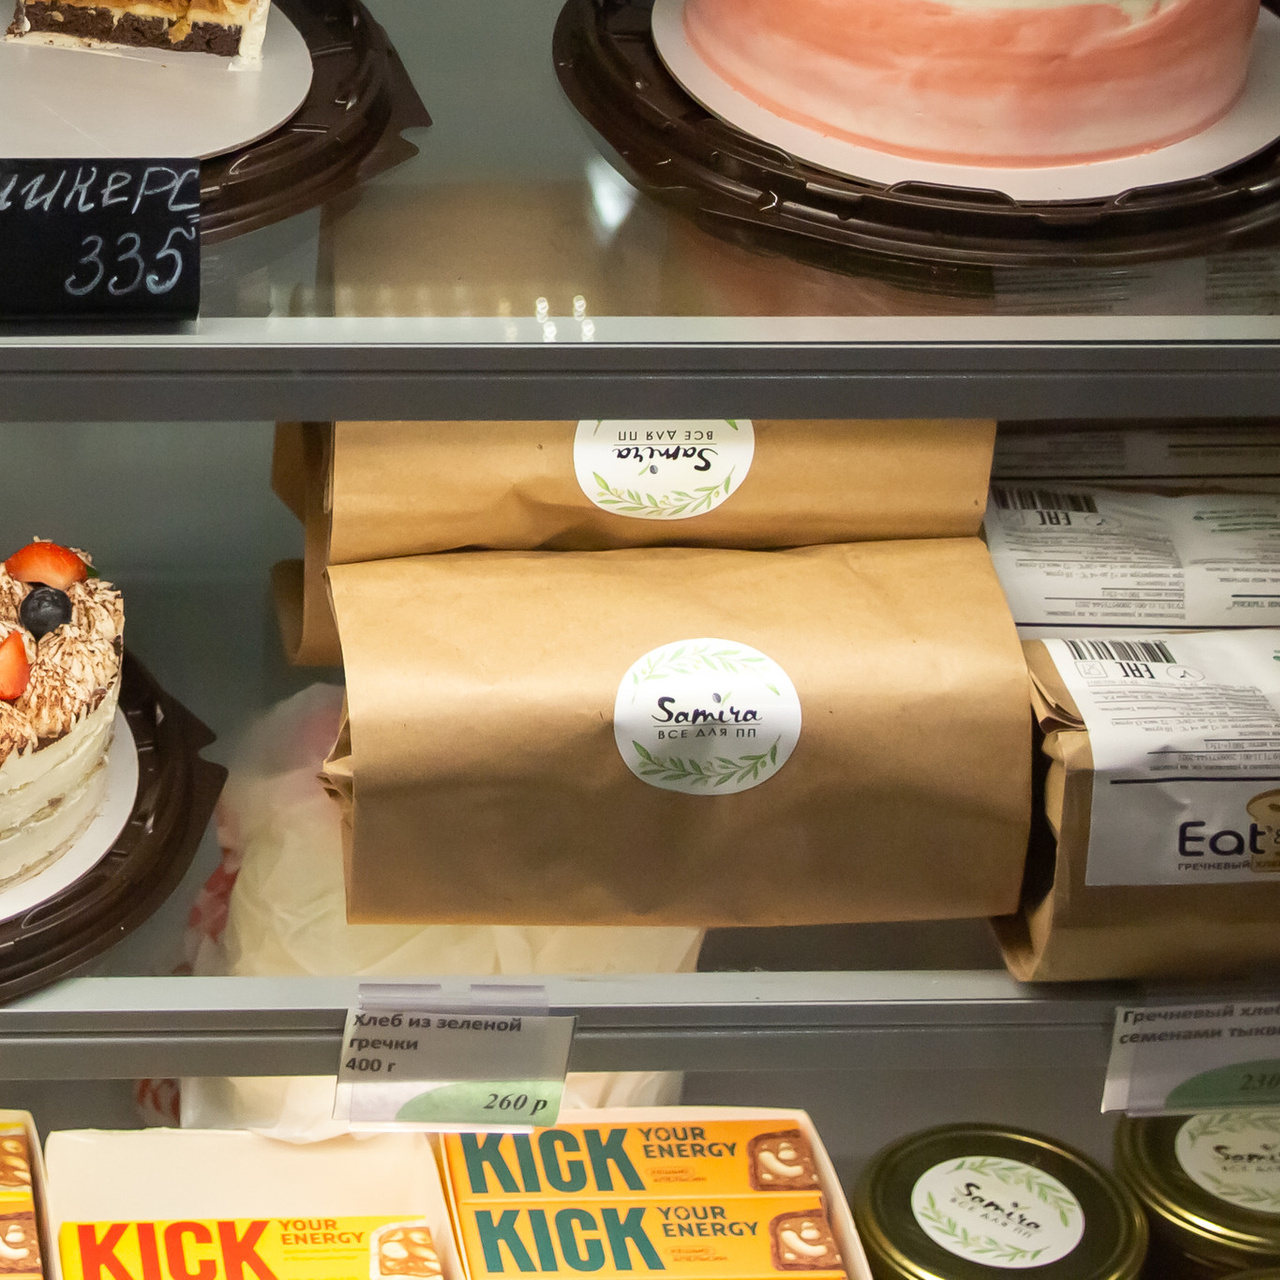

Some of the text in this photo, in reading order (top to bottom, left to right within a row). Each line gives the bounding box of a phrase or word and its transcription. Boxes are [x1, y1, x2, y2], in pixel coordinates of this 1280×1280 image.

[65, 227, 195, 296] 335
[618, 430, 713, 441] ВСЕ ДЛЯ ПП
[612, 445, 718, 474] Samira
[651, 692, 762, 724] Samira
[658, 728, 756, 740] ВСЕ ДЛЯ ПП
[353, 1013, 522, 1032] Хлеб из зеленой
[1123, 1004, 1235, 1025] Гречневый
[1120, 1025, 1280, 1045] семенами тыкв
[349, 1038, 418, 1052] гречки
[346, 1058, 397, 1072] 400 г
[483, 1093, 549, 1116] 260 р
[637, 1127, 706, 1141] YOUR
[643, 1142, 736, 1158] ENERGY
[1213, 1144, 1280, 1162] Sami
[459, 1128, 646, 1194] KICK
[656, 1206, 727, 1220] YOUR
[953, 1182, 1041, 1231] Samira
[278, 1219, 338, 1231] YOUR
[662, 1221, 758, 1237] ENERGY
[281, 1232, 365, 1245] ENERGY
[473, 1207, 666, 1273] KICK
[77, 1220, 278, 1280] KICK
